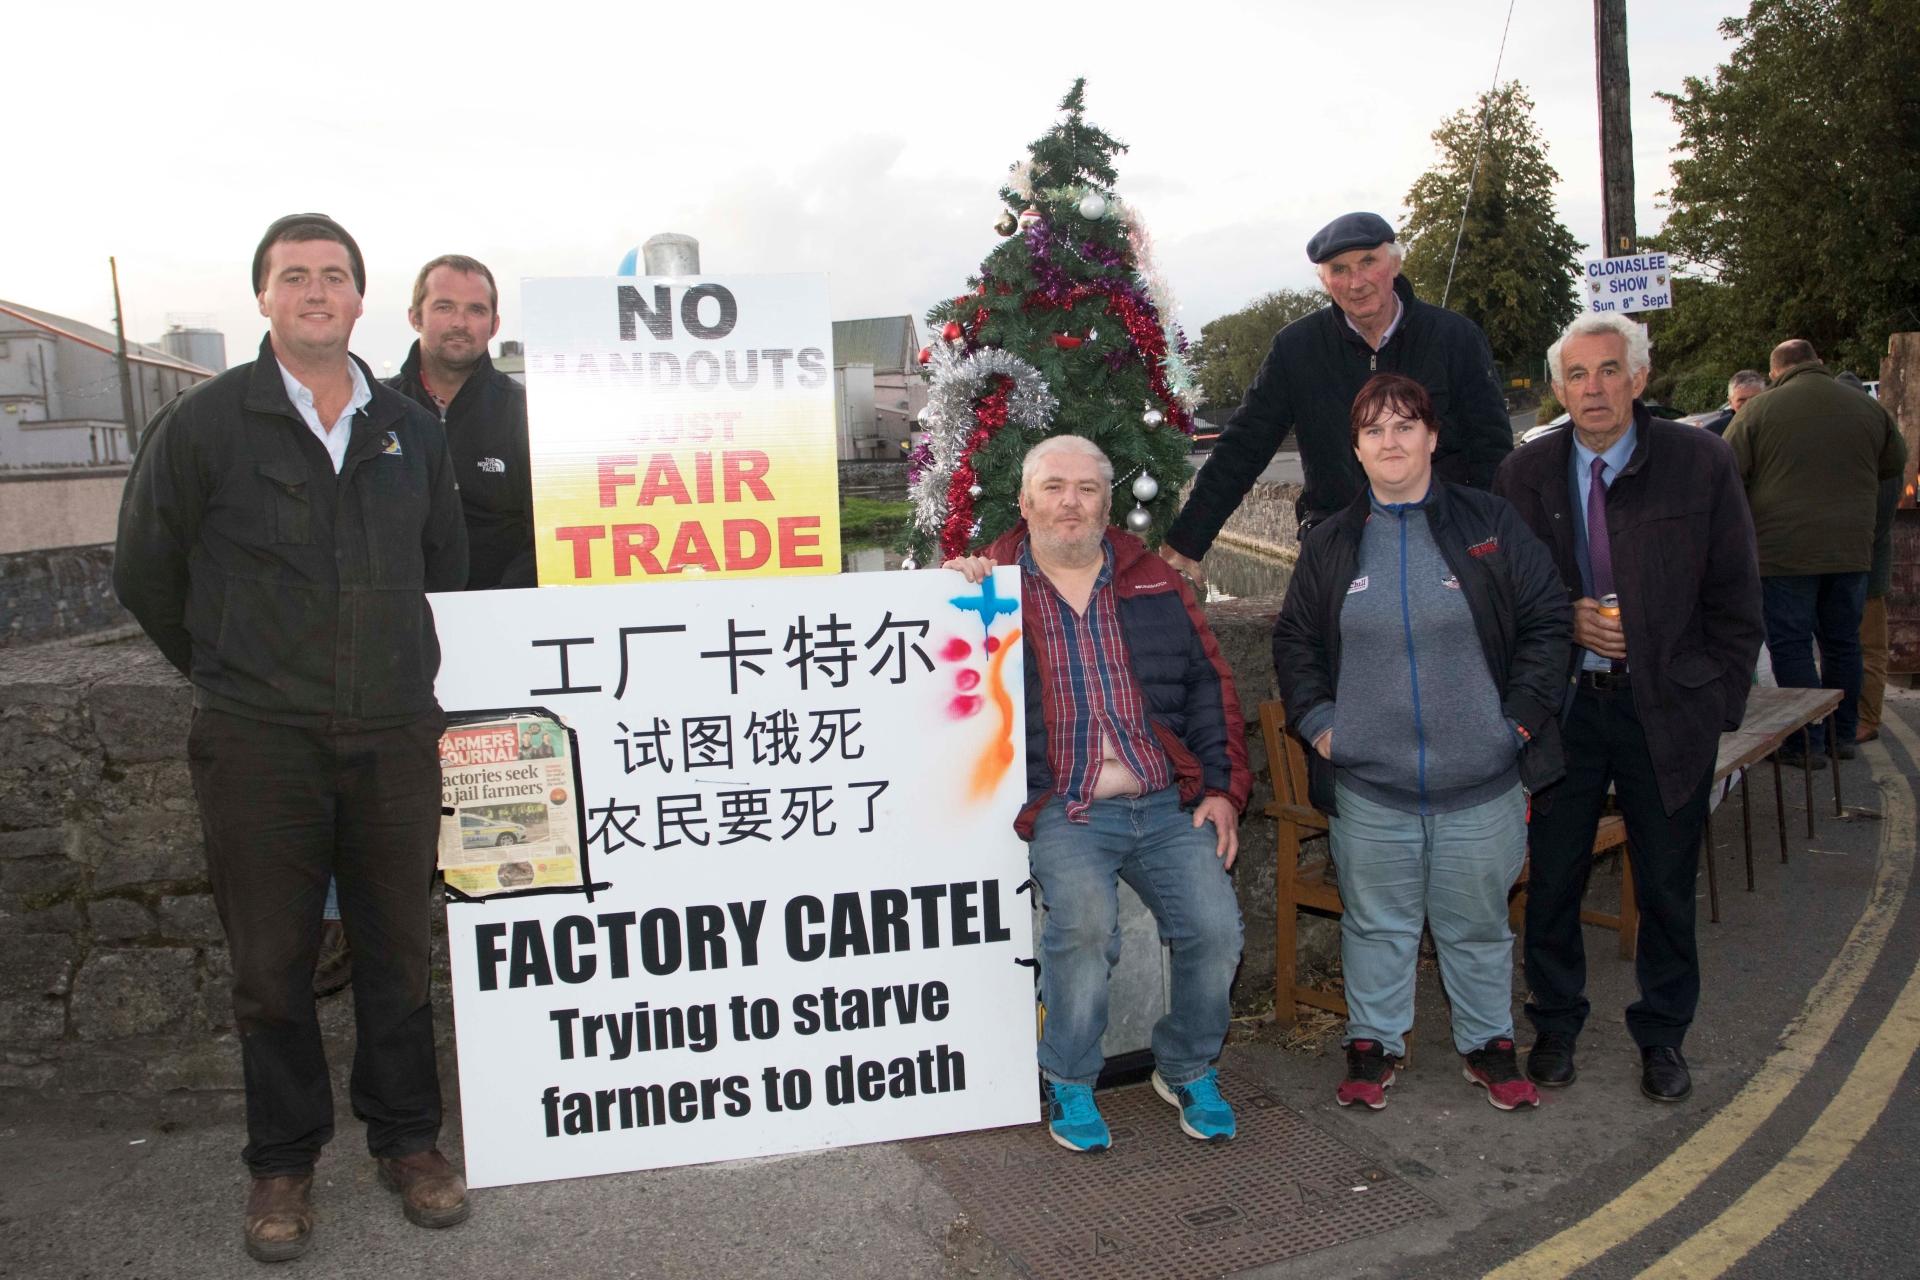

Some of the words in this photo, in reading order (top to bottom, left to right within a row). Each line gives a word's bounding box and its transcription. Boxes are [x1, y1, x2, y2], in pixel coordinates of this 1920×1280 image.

[1589, 255, 1665, 277] CLONASLEE
[1610, 276, 1648, 293] SHOW
[617, 283, 738, 341] NO
[1592, 300, 1615, 312] Sun
[1642, 293, 1668, 308] Sept
[529, 347, 827, 391] HANDOUTS
[597, 450, 775, 508] FAIR
[555, 515, 824, 579] TRADE
[531, 611, 937, 702] 工厂卡特尔
[441, 747, 519, 766] OURNAL
[614, 708, 866, 776] 试图饿死
[442, 768, 502, 788] actories
[505, 764, 539, 781] seek
[442, 790, 452, 803] o
[453, 785, 479, 806] jail
[483, 781, 544, 800] farmers
[587, 780, 889, 856] 农民要死了
[475, 899, 767, 992] FACTORY
[785, 878, 1011, 962] CARTEL
[549, 1003, 718, 1061] Trying
[729, 996, 780, 1042] to
[793, 980, 950, 1035] starve
[541, 1074, 752, 1138] farmers
[762, 1066, 812, 1113] to
[825, 1044, 966, 1107] death
